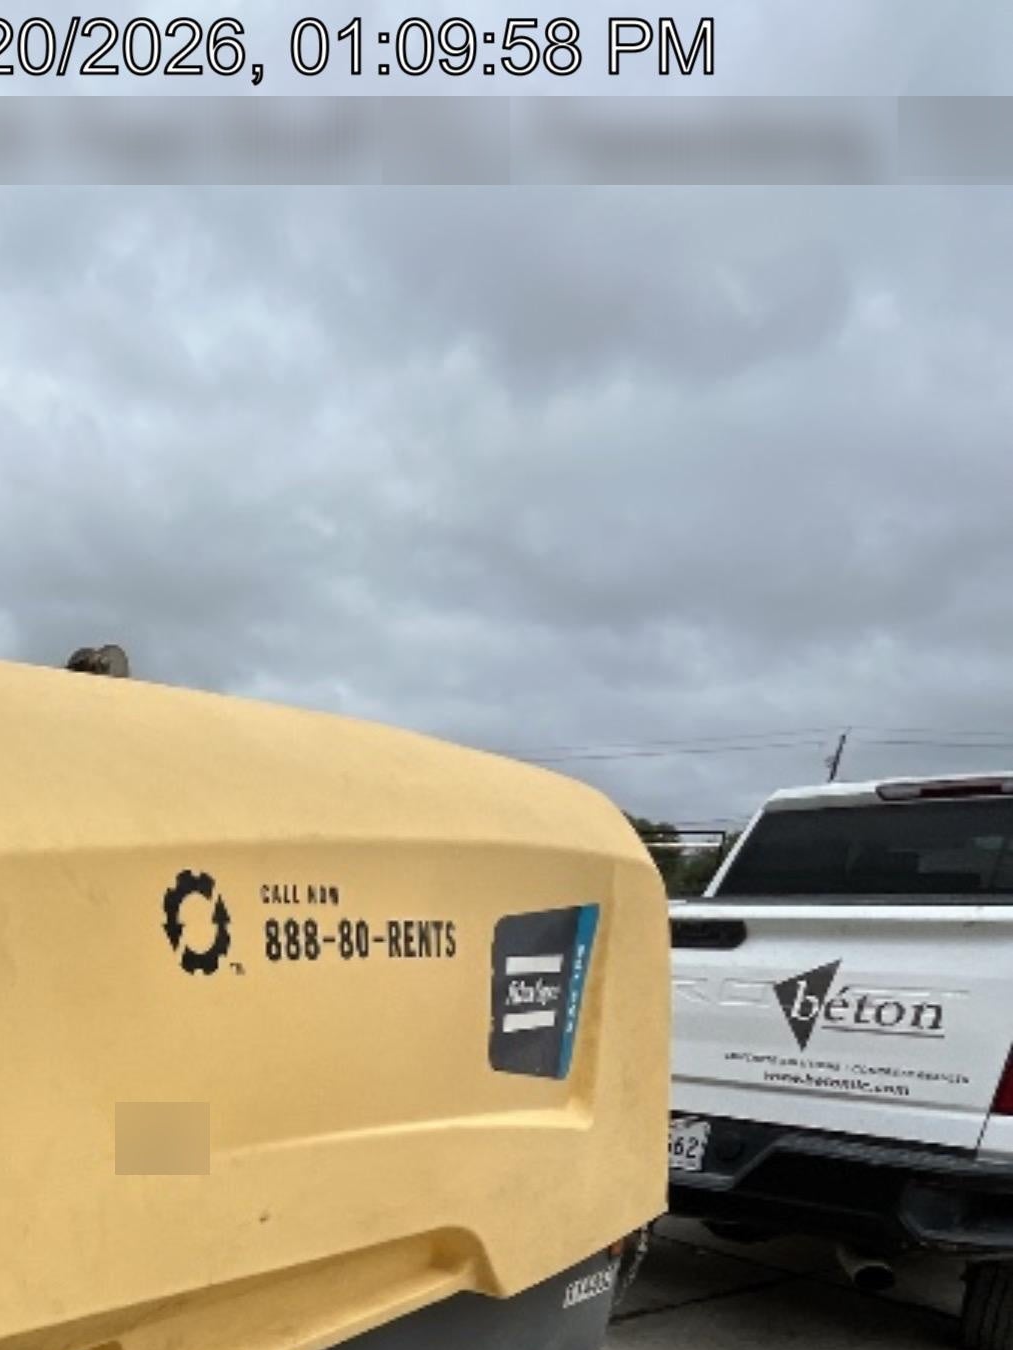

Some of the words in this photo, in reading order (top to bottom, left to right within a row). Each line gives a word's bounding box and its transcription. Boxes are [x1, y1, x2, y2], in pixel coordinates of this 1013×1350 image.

[261, 884, 300, 904] CALL
[307, 885, 340, 906] NOW
[265, 918, 456, 961] 888-80-RENTS
[791, 980, 943, 1030] béton
[669, 1134, 699, 1159] 62
